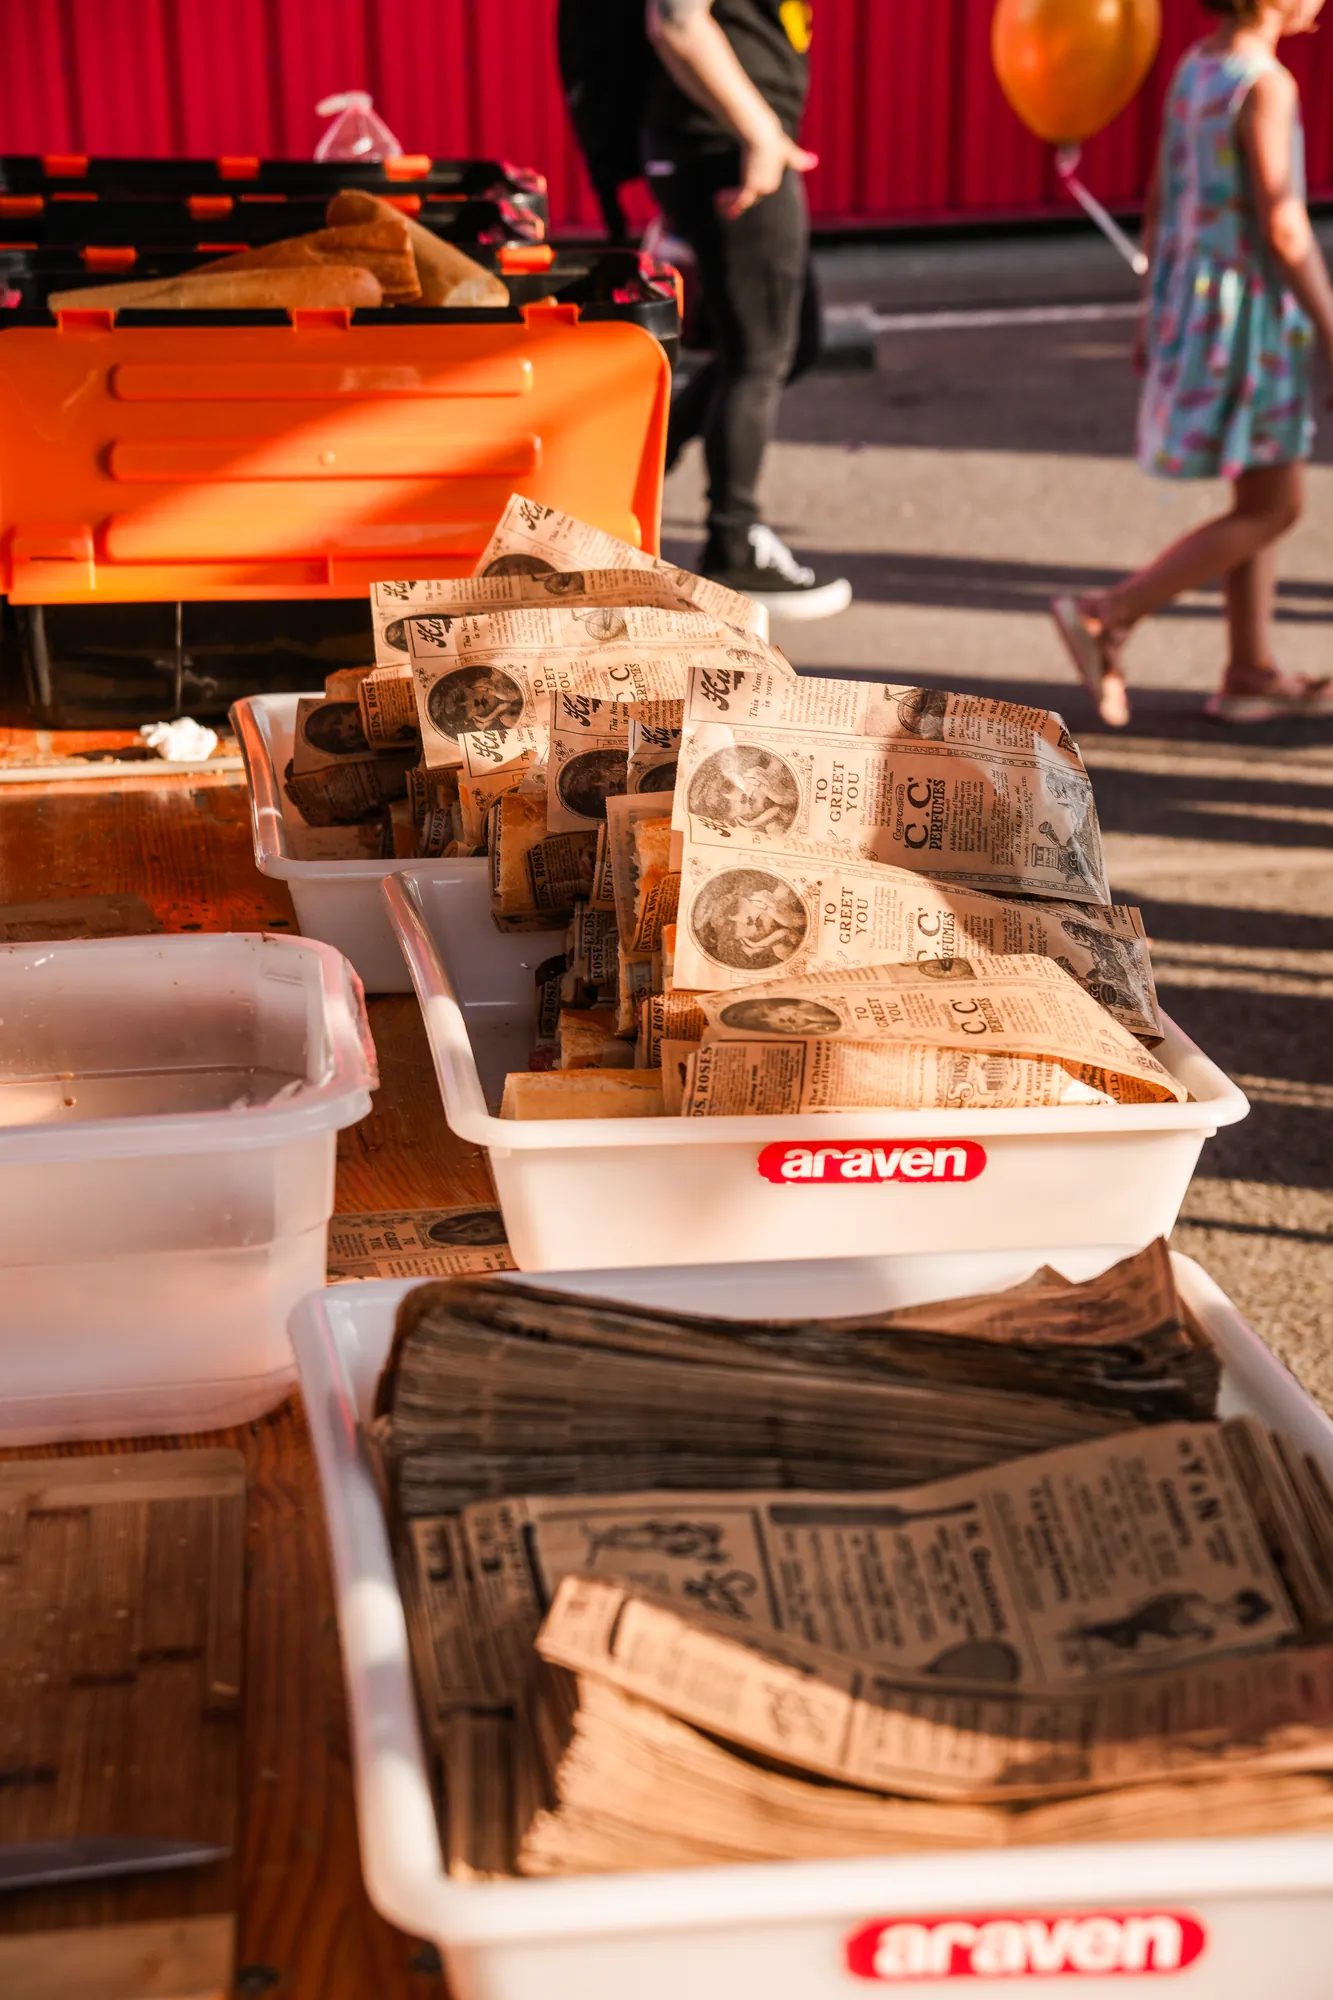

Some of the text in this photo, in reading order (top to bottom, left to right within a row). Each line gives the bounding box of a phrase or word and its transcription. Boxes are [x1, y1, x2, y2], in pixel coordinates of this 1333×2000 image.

[533, 679, 547, 698] TO
[543, 665, 559, 699] REET
[761, 675, 774, 708] is your
[748, 699, 760, 718] This
[950, 699, 960, 716] from
[814, 777, 829, 804] TO
[829, 760, 845, 823] GREET
[845, 771, 860, 813] YOU
[928, 778, 947, 852] PERFUMES
[531, 844, 546, 878] ROSES
[823, 902, 837, 926] TO
[839, 886, 854, 945] GREET
[855, 897, 869, 936] YOU
[941, 911, 956, 960] RFUMES
[854, 1005, 869, 1021] TO
[866, 997, 890, 1029] GREET
[885, 1002, 904, 1023] YOU
[696, 1046, 713, 1094] ROSES
[808, 1088, 819, 1107] The
[780, 1147, 968, 1179] araven
[873, 1915, 1182, 1974] araven
